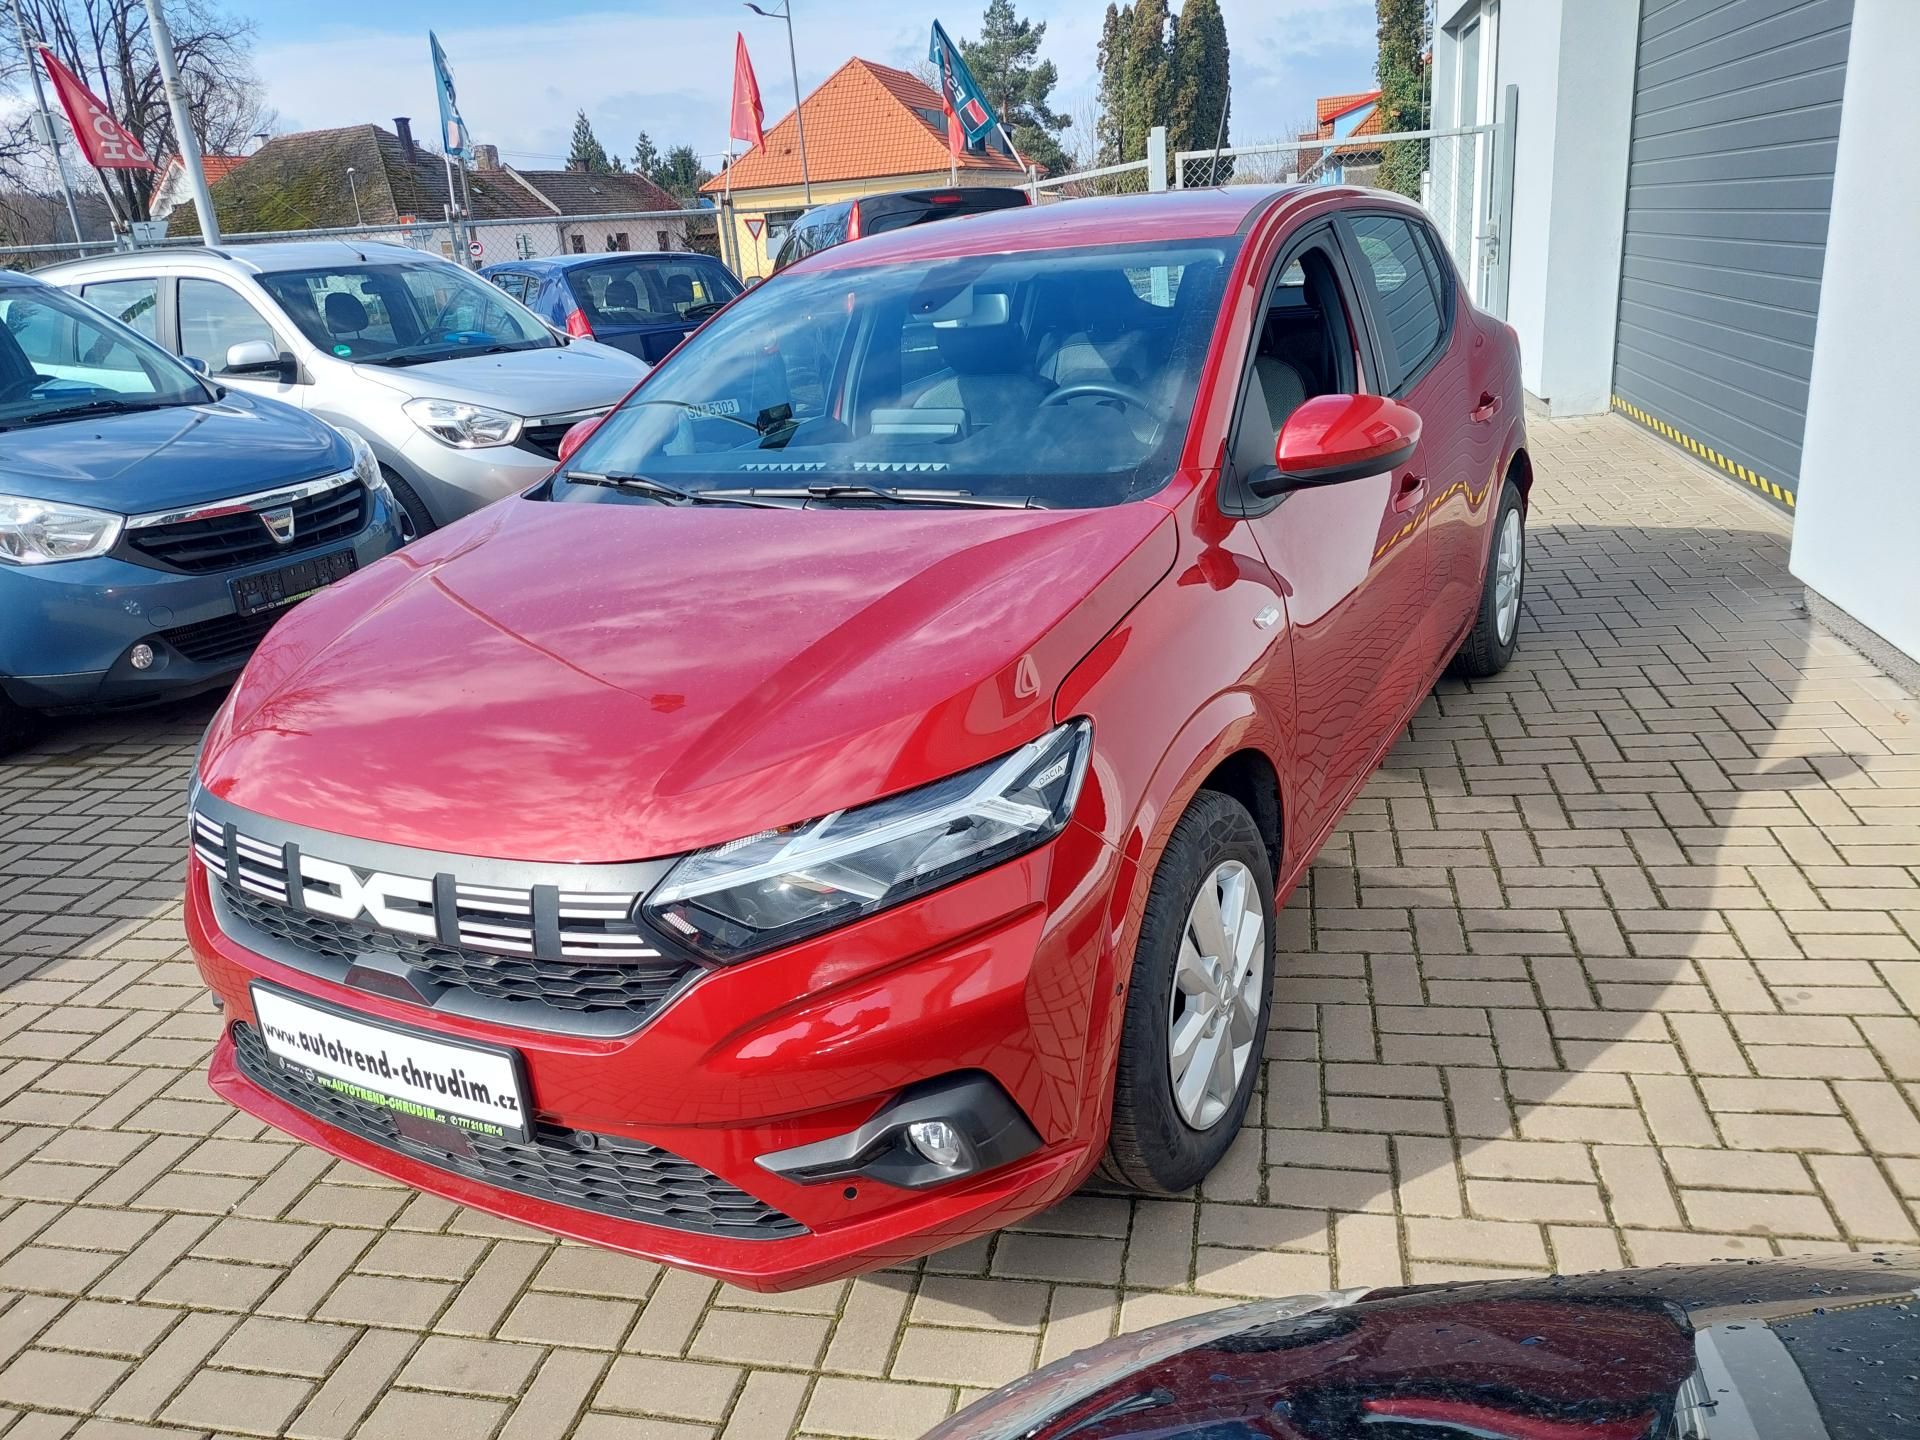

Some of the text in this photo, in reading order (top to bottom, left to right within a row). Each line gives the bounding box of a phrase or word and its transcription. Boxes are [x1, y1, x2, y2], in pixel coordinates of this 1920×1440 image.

[708, 400, 735, 416] 5303
[1038, 765, 1063, 786] DACIA
[263, 1021, 519, 1111] www.autotrend-chrudim.cz
